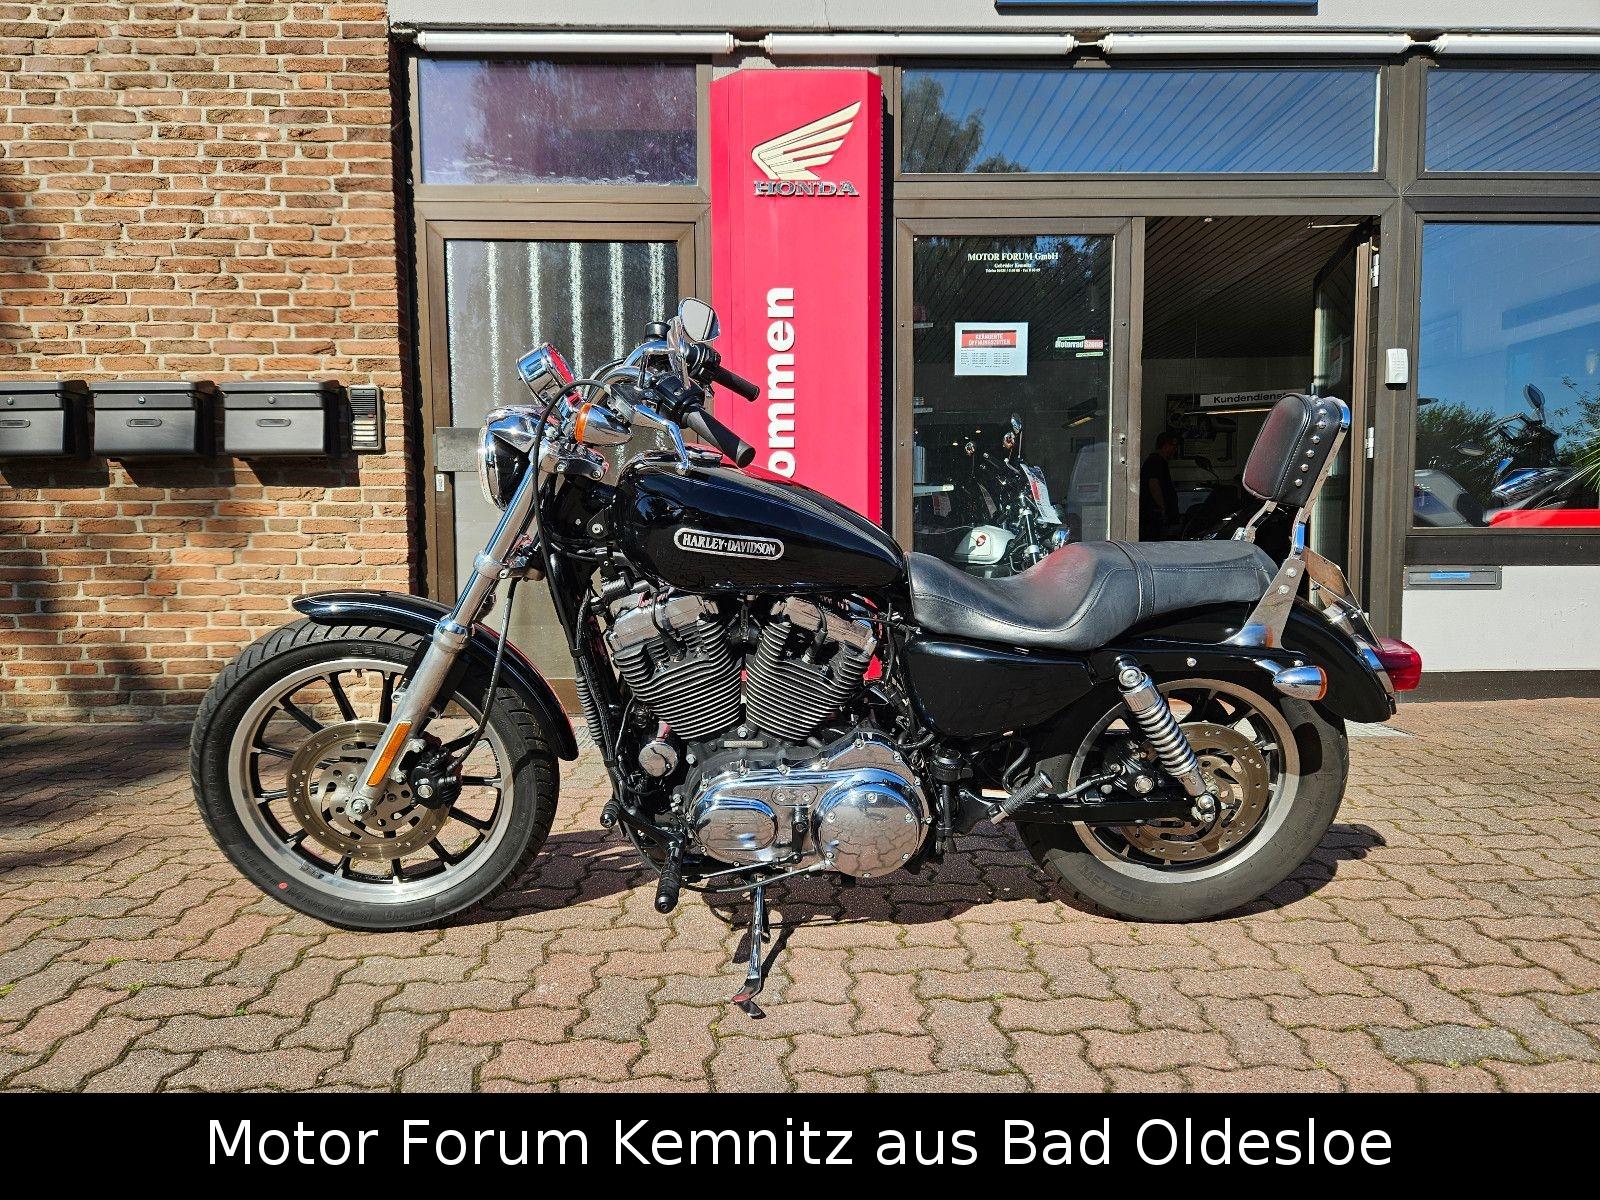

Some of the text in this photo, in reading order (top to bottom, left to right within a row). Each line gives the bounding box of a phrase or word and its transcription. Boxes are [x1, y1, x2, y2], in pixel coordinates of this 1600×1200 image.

[754, 180, 859, 197] HONDA
[967, 252, 1059, 261] MOTOR FORUM GmbH
[1055, 340, 1084, 348] Motorrad
